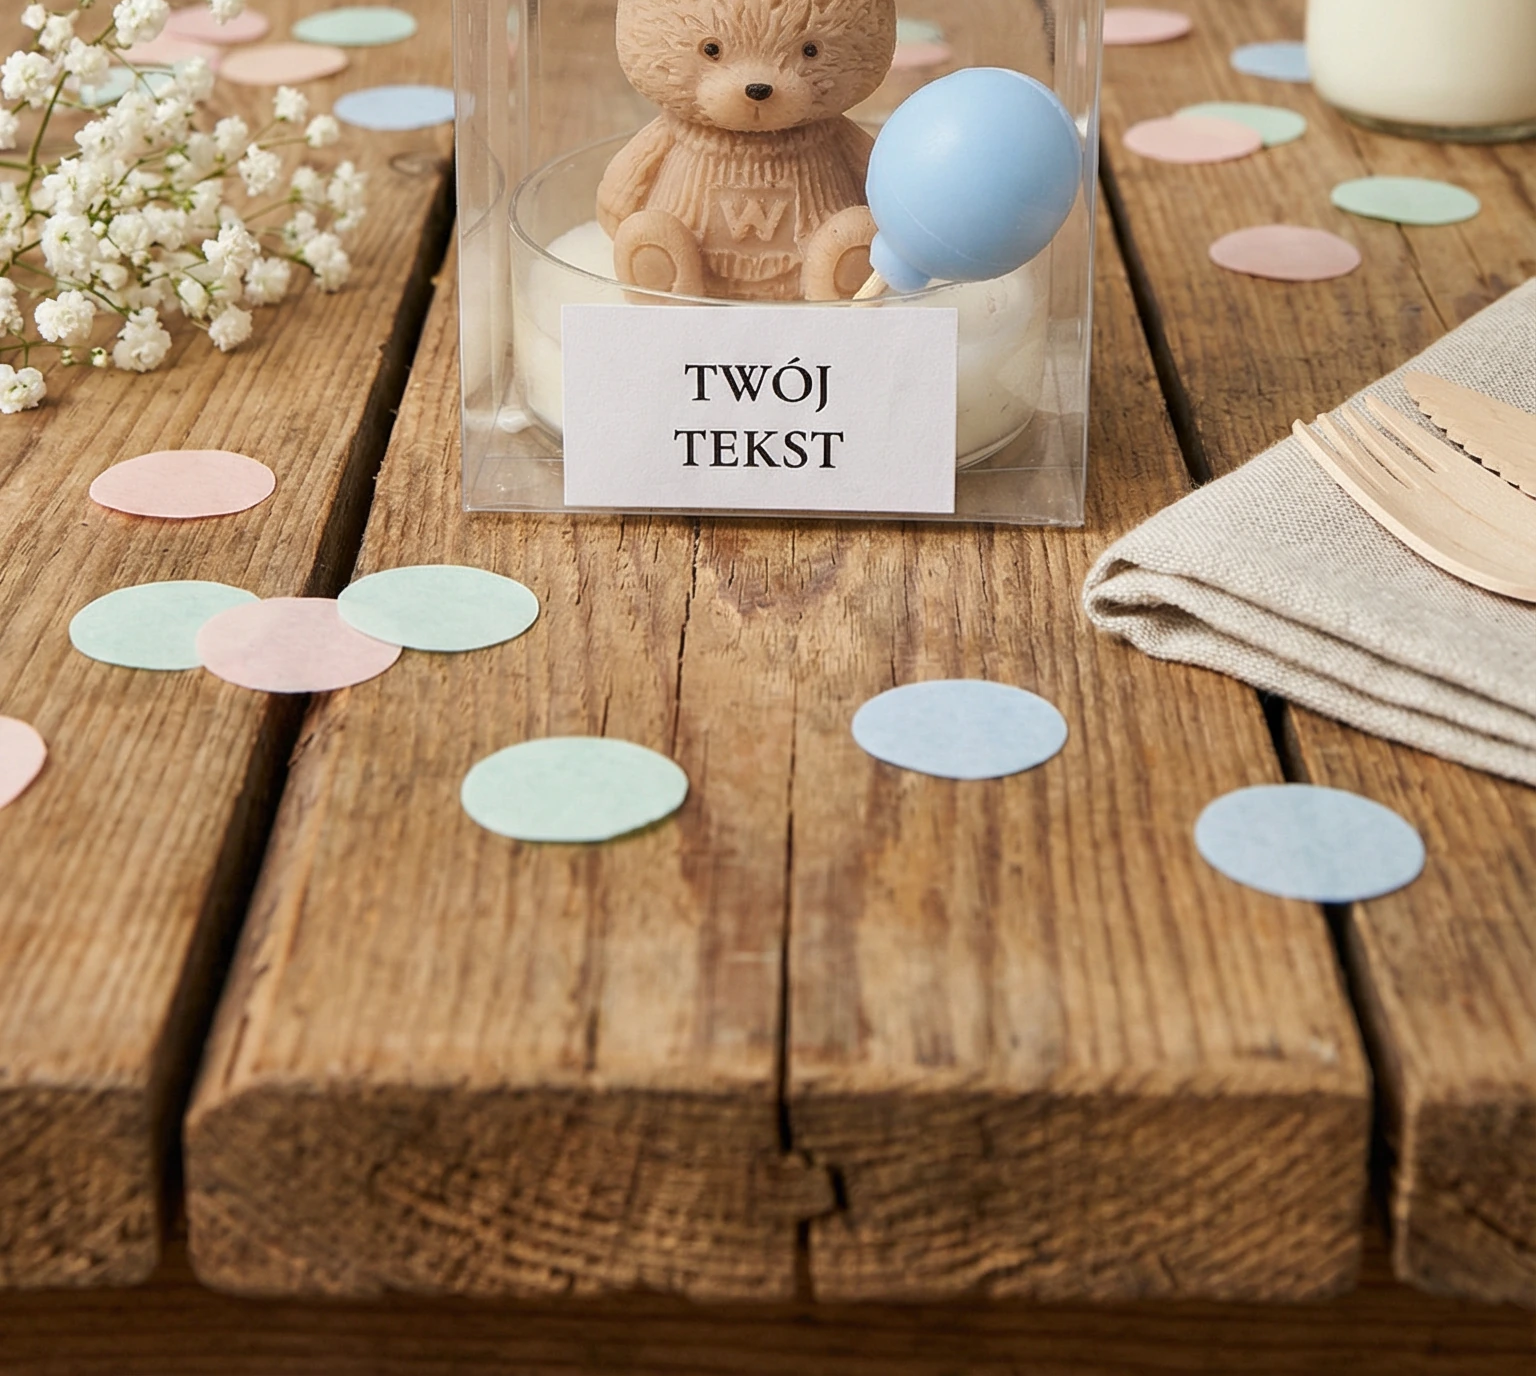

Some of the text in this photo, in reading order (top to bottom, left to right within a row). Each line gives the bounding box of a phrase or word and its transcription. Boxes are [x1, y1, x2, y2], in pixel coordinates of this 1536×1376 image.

[718, 197, 792, 242] W
[684, 357, 832, 413] TWÓJ
[673, 429, 844, 469] TEKST
